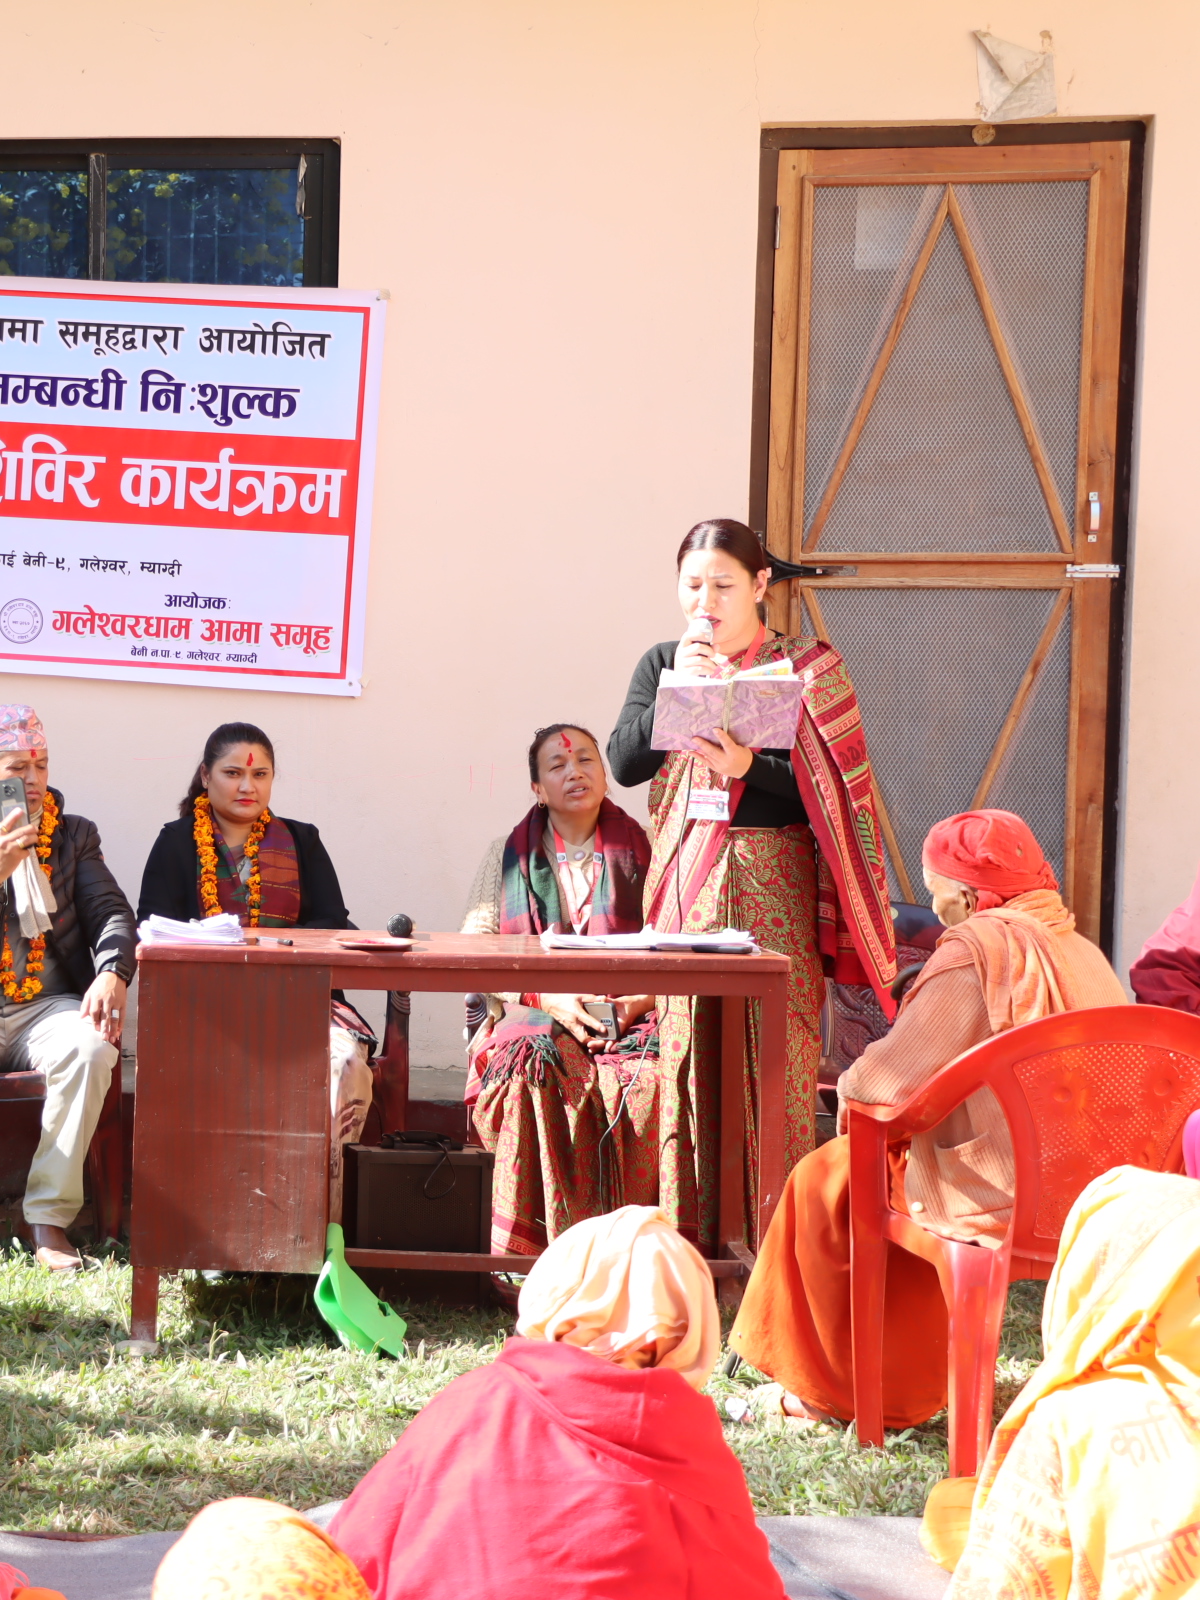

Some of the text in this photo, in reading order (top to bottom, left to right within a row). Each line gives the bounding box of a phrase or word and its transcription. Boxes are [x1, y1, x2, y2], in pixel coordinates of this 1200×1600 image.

[58, 320, 184, 355] समूहद्वारा
[199, 321, 331, 358] आयोजित
[120, 448, 347, 518] कार्यक्रम
[80, 556, 131, 576] गलेश्वर,
[140, 560, 182, 577] म्याग्दी
[52, 604, 193, 641] गलेश्वरधाम
[200, 618, 263, 645] आमा
[270, 623, 334, 656] समूह
[130, 645, 148, 657] बेनी
